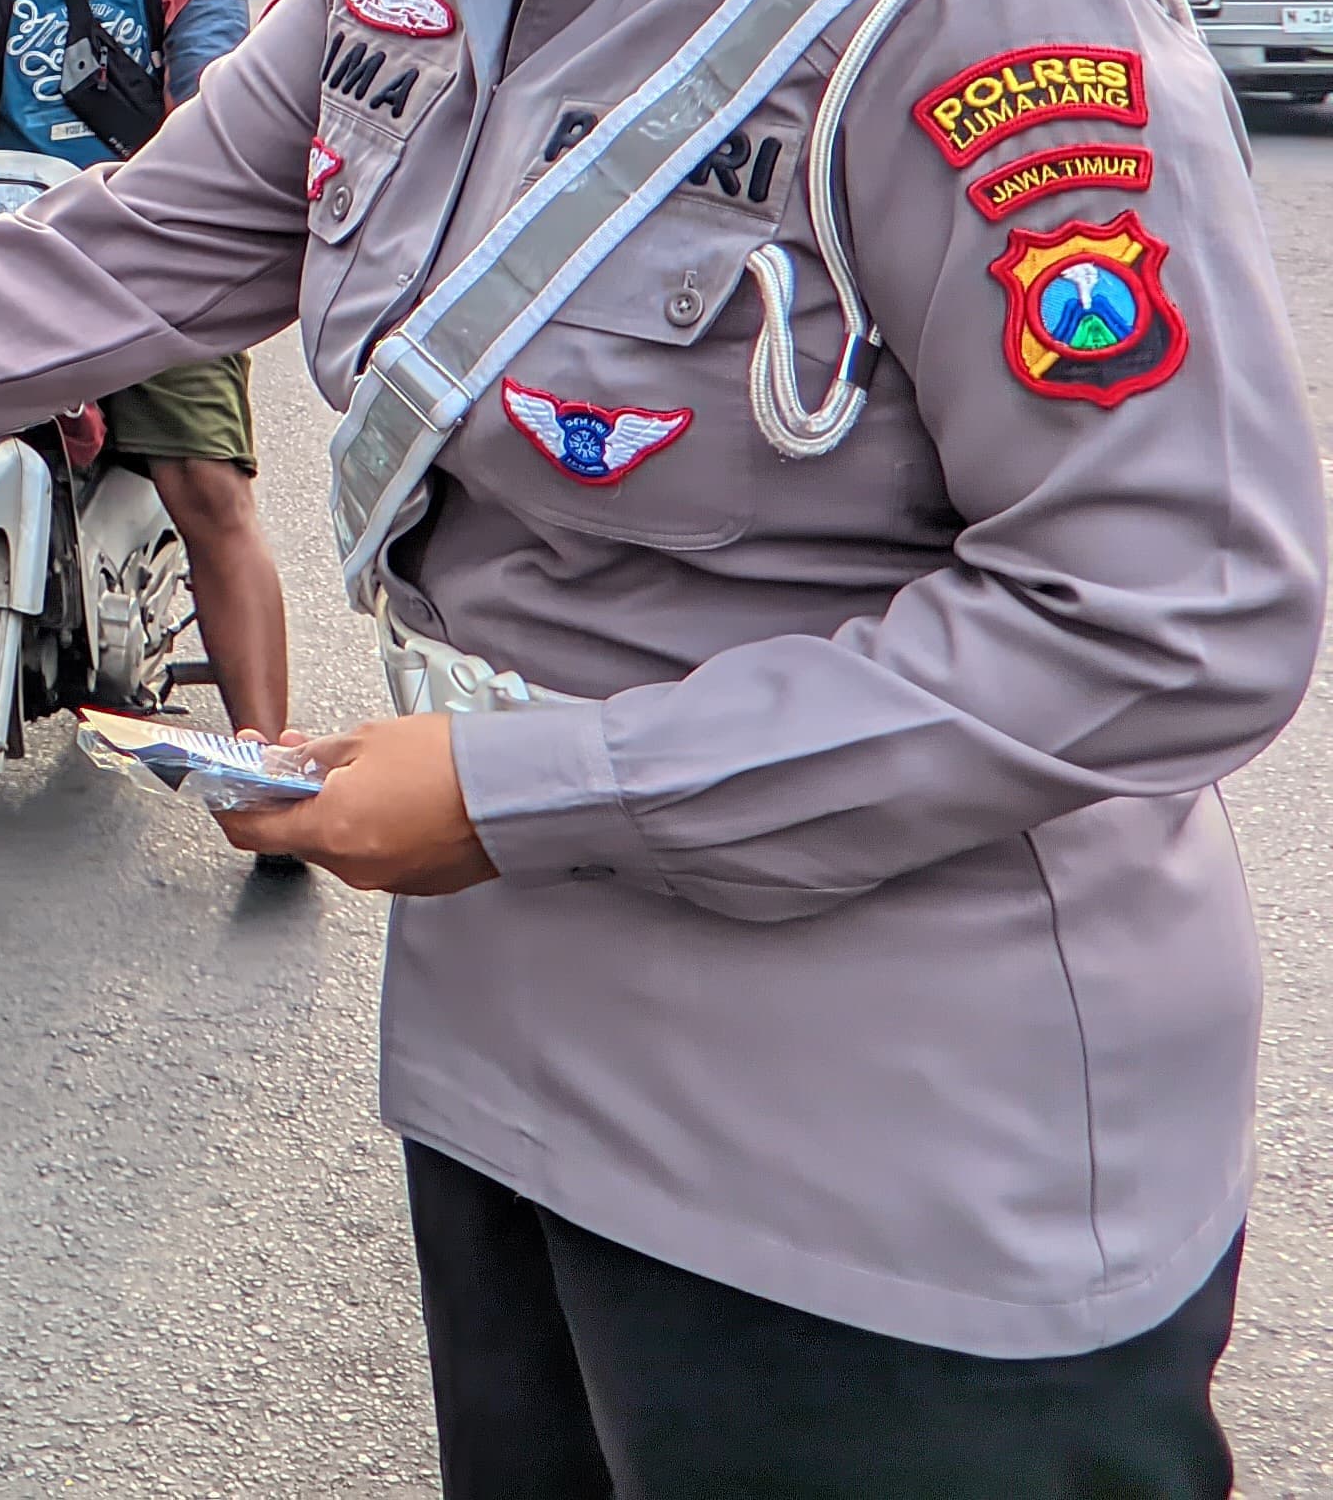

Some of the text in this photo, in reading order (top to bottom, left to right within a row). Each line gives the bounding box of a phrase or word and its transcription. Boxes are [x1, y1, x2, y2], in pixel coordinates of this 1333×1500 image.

[933, 58, 1127, 131] POLRES
[950, 83, 1129, 150] LUMAJANG
[544, 110, 783, 203] PRI
[992, 156, 1138, 204] JAWA TIMUR
